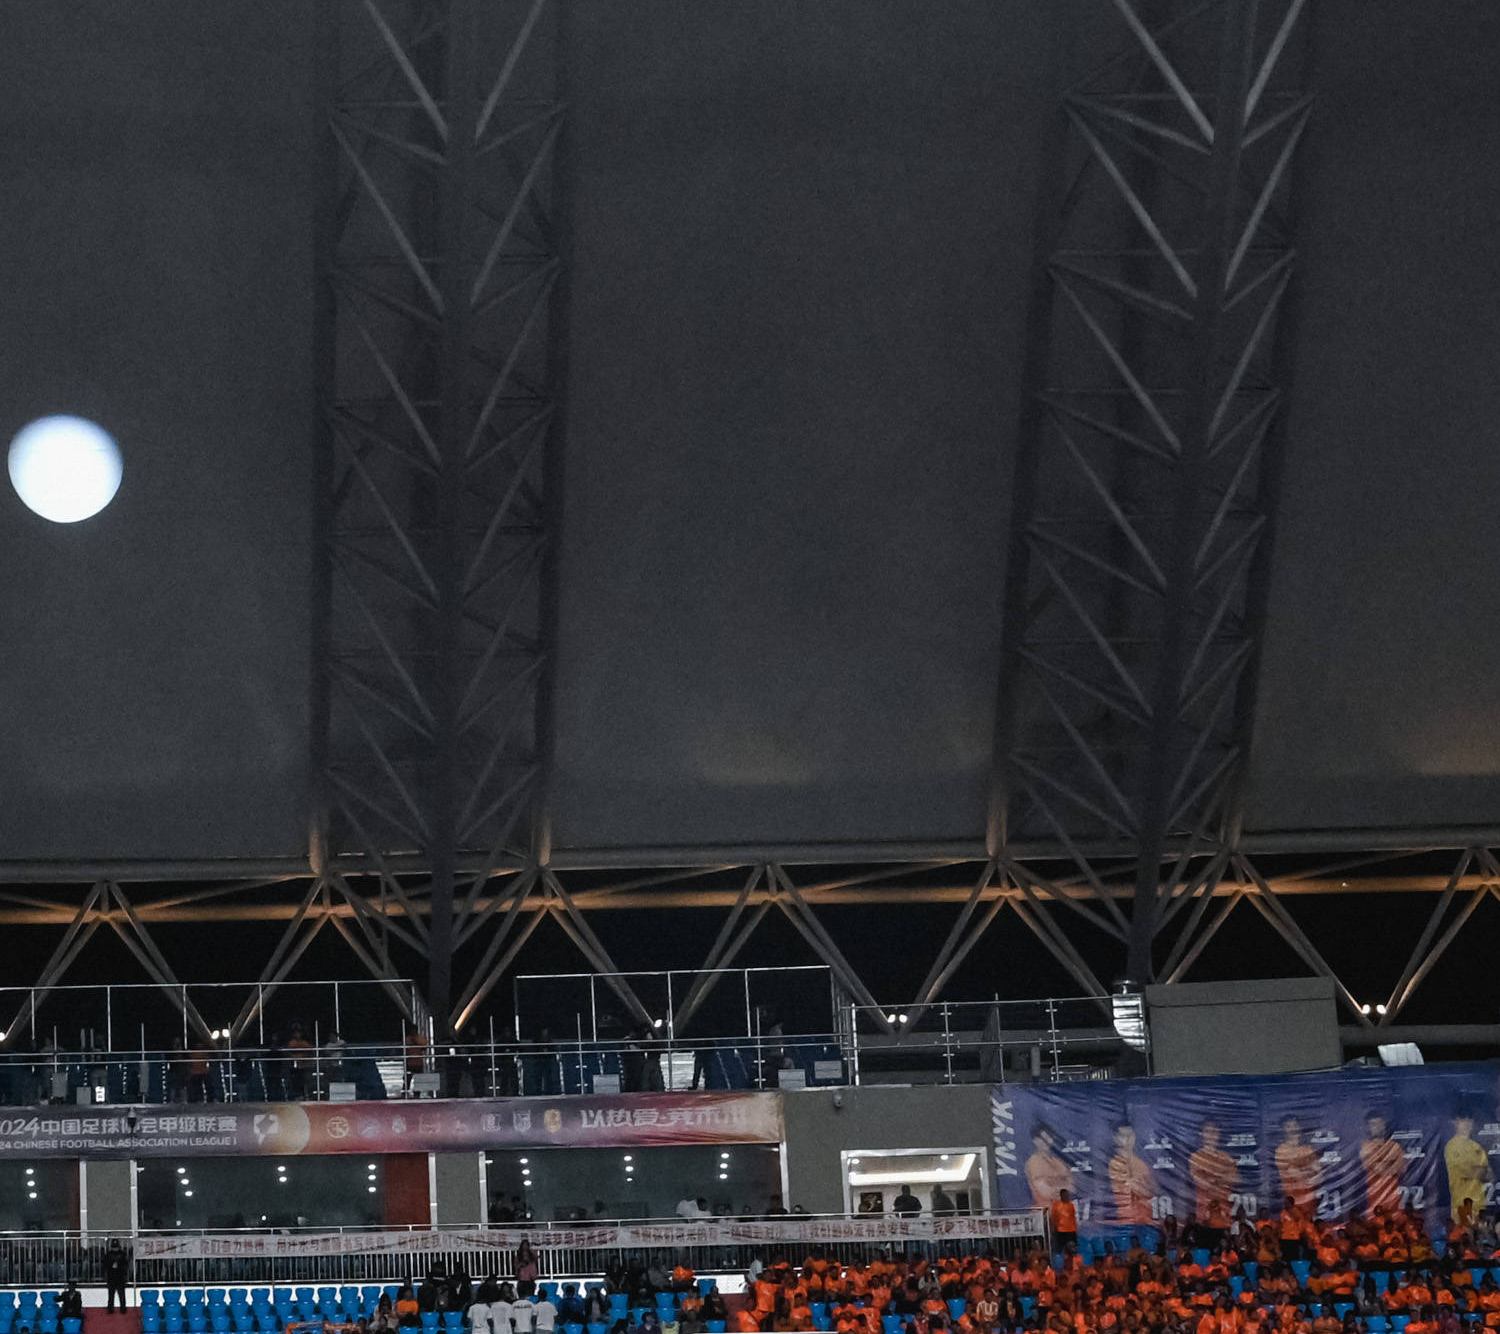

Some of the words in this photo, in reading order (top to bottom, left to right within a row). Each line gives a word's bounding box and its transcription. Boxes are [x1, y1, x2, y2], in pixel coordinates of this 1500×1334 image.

[13, 1140, 58, 1149] CHINESE
[60, 1139, 115, 1149] FOOTBALL
[118, 1137, 188, 1147] ASSOCIATION
[189, 1137, 232, 1146] LEAGUE
[1148, 1196, 1173, 1220] 18
[1398, 1186, 1425, 1210] 22
